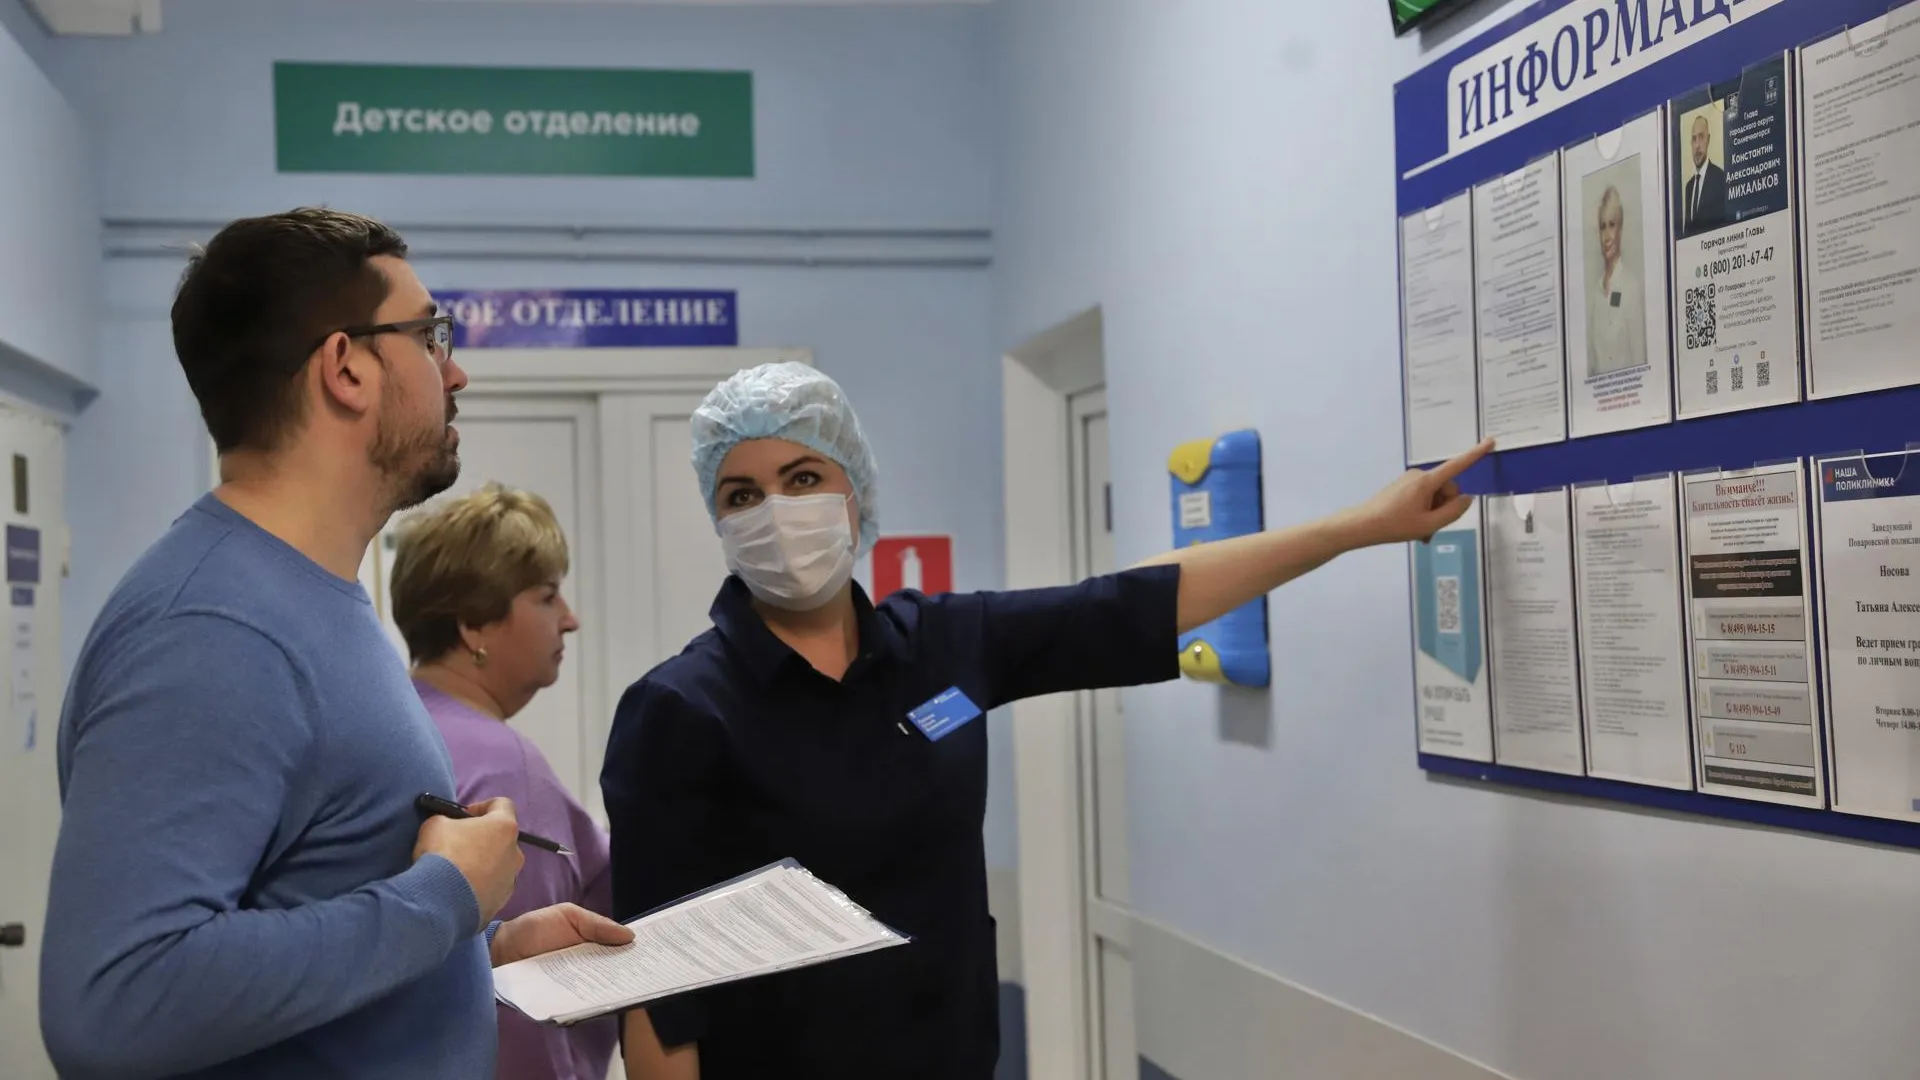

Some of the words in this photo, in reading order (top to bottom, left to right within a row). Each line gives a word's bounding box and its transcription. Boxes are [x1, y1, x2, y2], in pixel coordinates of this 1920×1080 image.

[333, 102, 492, 136] Детское
[504, 110, 701, 138] отделение
[1744, 110, 1758, 120] Глава
[1729, 123, 1757, 137] городского
[1757, 116, 1774, 128] округа
[1733, 128, 1771, 146] Солнечногорск
[1731, 144, 1773, 164] Константин
[1726, 158, 1780, 183] Александрович
[1728, 174, 1779, 200] МИХАЛЬКОВ
[1701, 236, 1725, 250] Горячая
[1726, 232, 1745, 246] линия
[1746, 225, 1765, 240] Главы
[1703, 263, 1708, 278] 8
[1710, 258, 1730, 279] (800)
[1732, 247, 1774, 270] 201-67-47
[511, 297, 728, 328] ОТДЕЛЕНИЕ
[1835, 467, 1857, 478] НАША
[1767, 491, 1794, 505] жизнь!
[1872, 521, 1912, 533] Заведующий
[1848, 536, 1890, 549] Поваровской
[1880, 565, 1910, 577] Носова
[1856, 601, 1889, 613] Татьяна
[1856, 636, 1878, 649] Ведет
[1880, 638, 1905, 652] прием
[1857, 657, 1867, 666] по
[1869, 657, 1902, 667] личным
[1904, 657, 1920, 669] воп
[1736, 743, 1746, 754] 112
